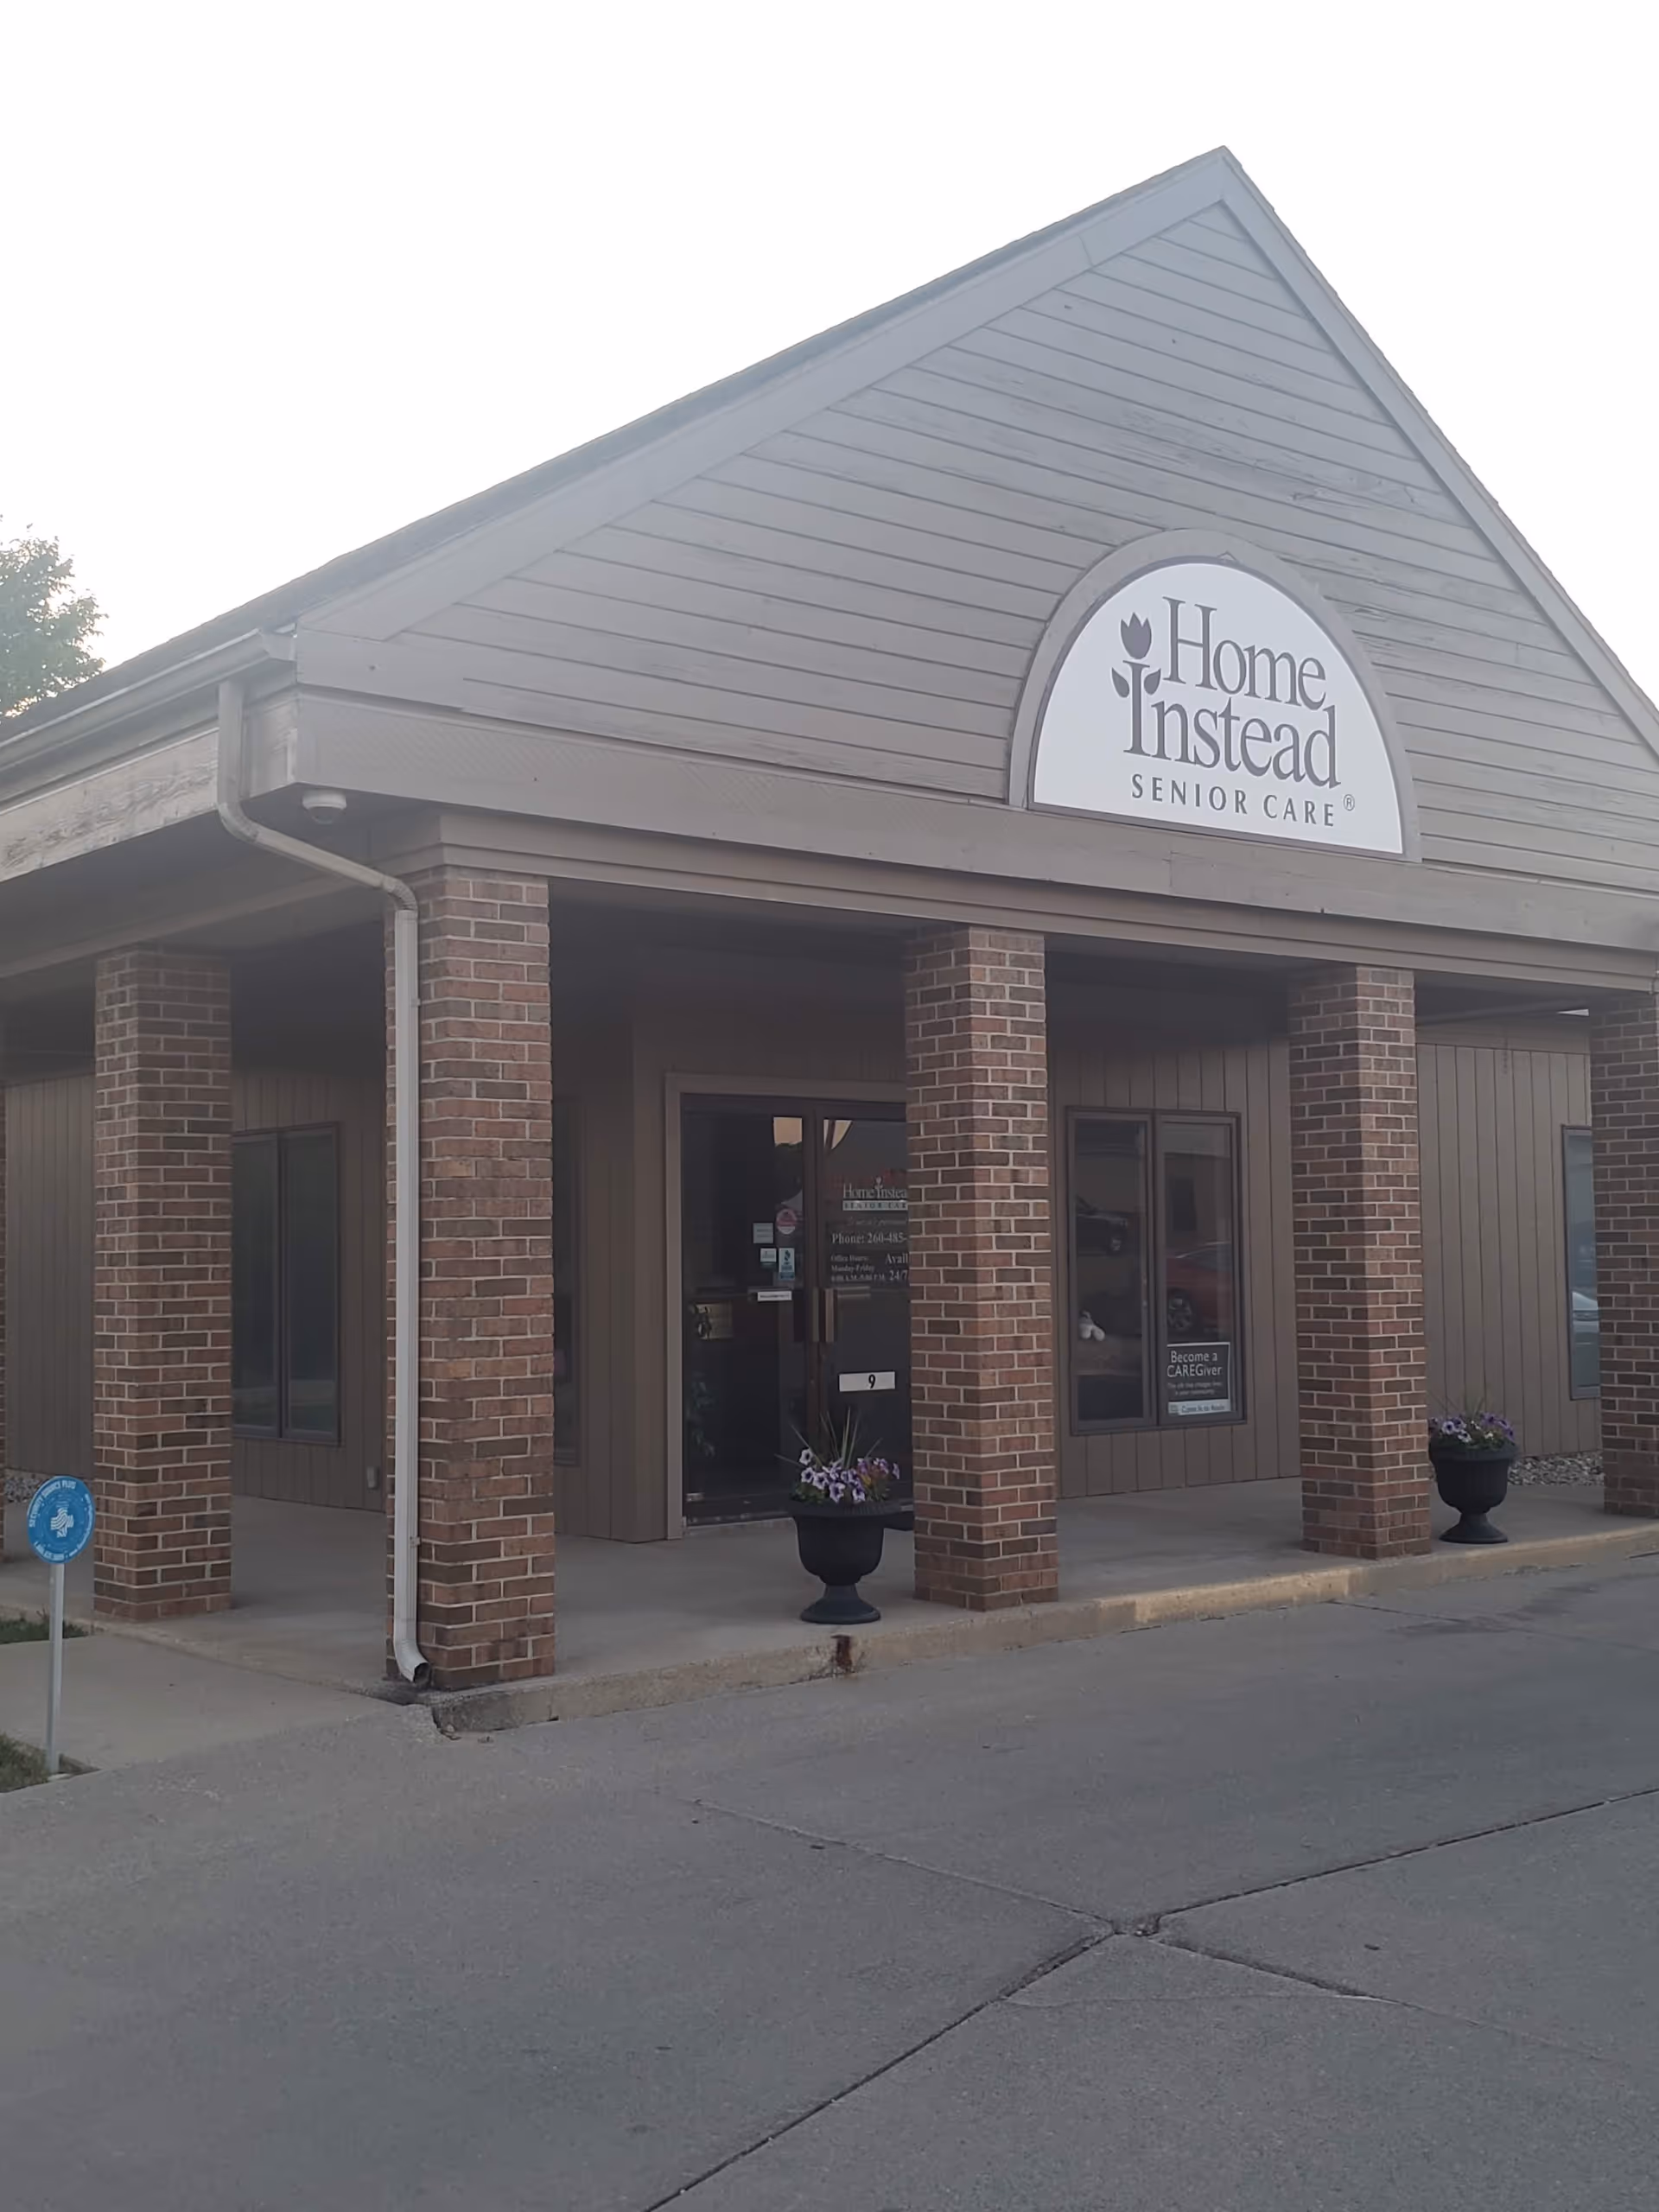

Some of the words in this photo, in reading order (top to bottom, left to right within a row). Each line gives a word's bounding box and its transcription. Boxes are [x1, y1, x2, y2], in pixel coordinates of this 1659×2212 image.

[1162, 596, 1326, 710] Home
[1123, 660, 1341, 789] Instead
[1132, 773, 1248, 815] SENIOR
[1263, 794, 1334, 827] CARE
[843, 1182, 874, 1199] Home
[874, 1186, 906, 1199] Instea
[832, 1232, 864, 1245] Phone:
[867, 1231, 907, 1244] 260-485-
[885, 1253, 909, 1264] Avail
[889, 1269, 908, 1281] 24/7
[1171, 1350, 1210, 1363] Become
[1167, 1363, 1223, 1377] CAREGiver
[868, 1374, 876, 1389] 9
